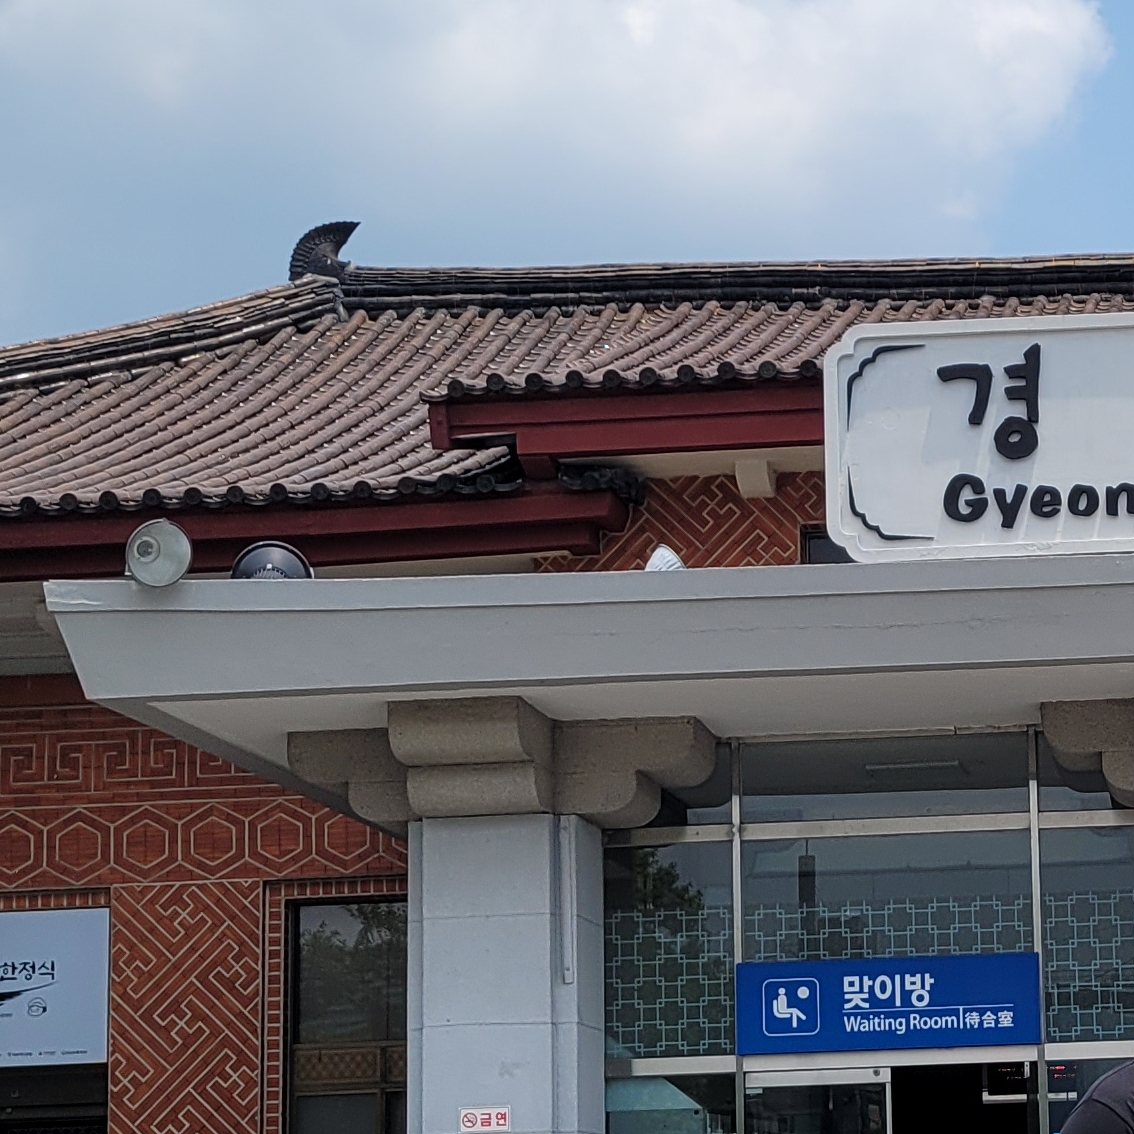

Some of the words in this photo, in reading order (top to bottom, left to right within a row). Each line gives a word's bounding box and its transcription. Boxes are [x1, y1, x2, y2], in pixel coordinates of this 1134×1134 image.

[937, 343, 1040, 461] 경
[0, 960, 55, 981] 한정식
[843, 973, 934, 1009] 맞이방
[843, 1014, 906, 1034] Waiting
[909, 1013, 957, 1030] Room
[964, 1010, 1014, 1029] 待合室
[480, 1112, 507, 1126] 금연
